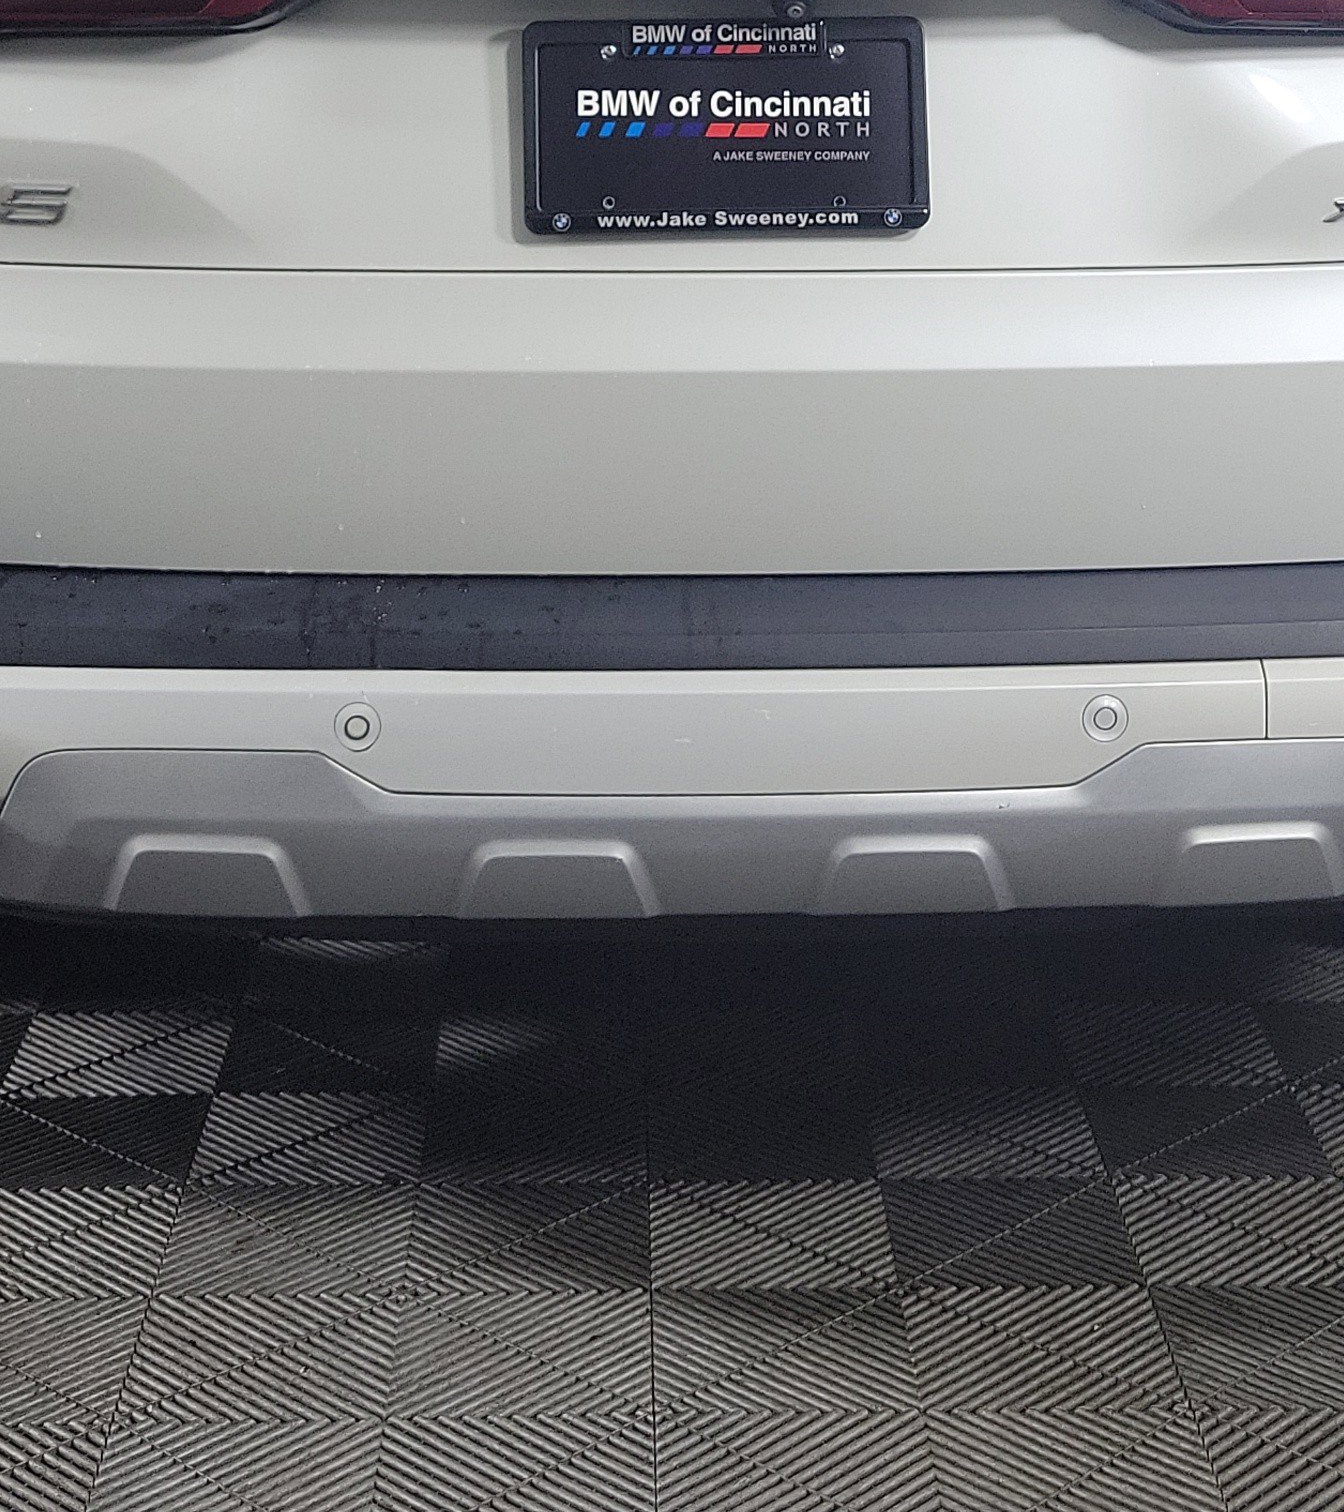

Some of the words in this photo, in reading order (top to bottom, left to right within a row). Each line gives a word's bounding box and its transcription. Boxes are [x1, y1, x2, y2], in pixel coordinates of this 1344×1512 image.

[632, 25, 686, 43] BMW
[691, 24, 712, 42] of
[717, 23, 817, 42] Cincinnati
[768, 44, 817, 53] NORTH
[577, 90, 660, 117] BMW
[669, 90, 701, 117] of
[710, 90, 871, 117] Cincinnati
[774, 122, 870, 137] NORTH
[713, 151, 722, 161] A
[724, 151, 753, 161] JAKE
[756, 151, 812, 161] SWEENEY
[814, 151, 870, 161] COMPANY
[597, 212, 707, 227] www.Jake
[714, 211, 859, 228] Sweeney.com
